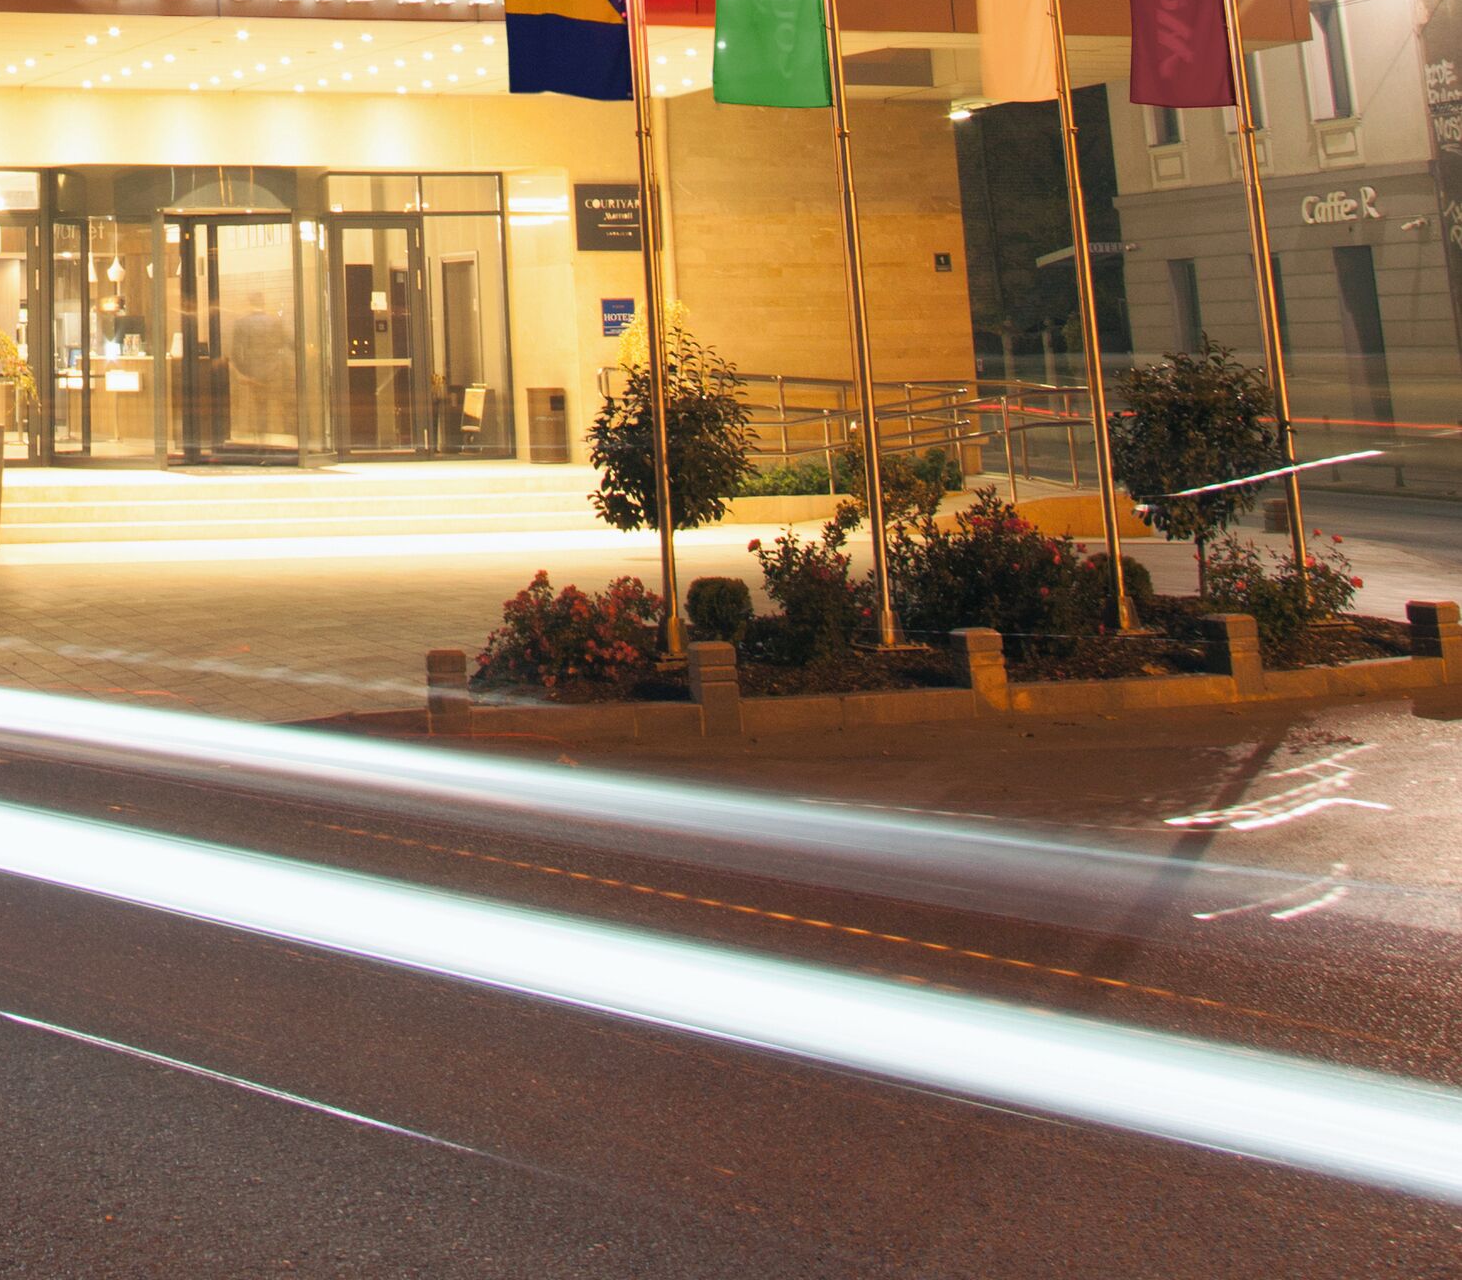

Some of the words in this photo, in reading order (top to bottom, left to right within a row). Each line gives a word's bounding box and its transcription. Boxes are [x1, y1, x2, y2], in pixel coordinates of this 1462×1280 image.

[584, 199, 640, 209] COURTYAR
[1301, 191, 1358, 225] Caffe
[1359, 186, 1382, 219] R
